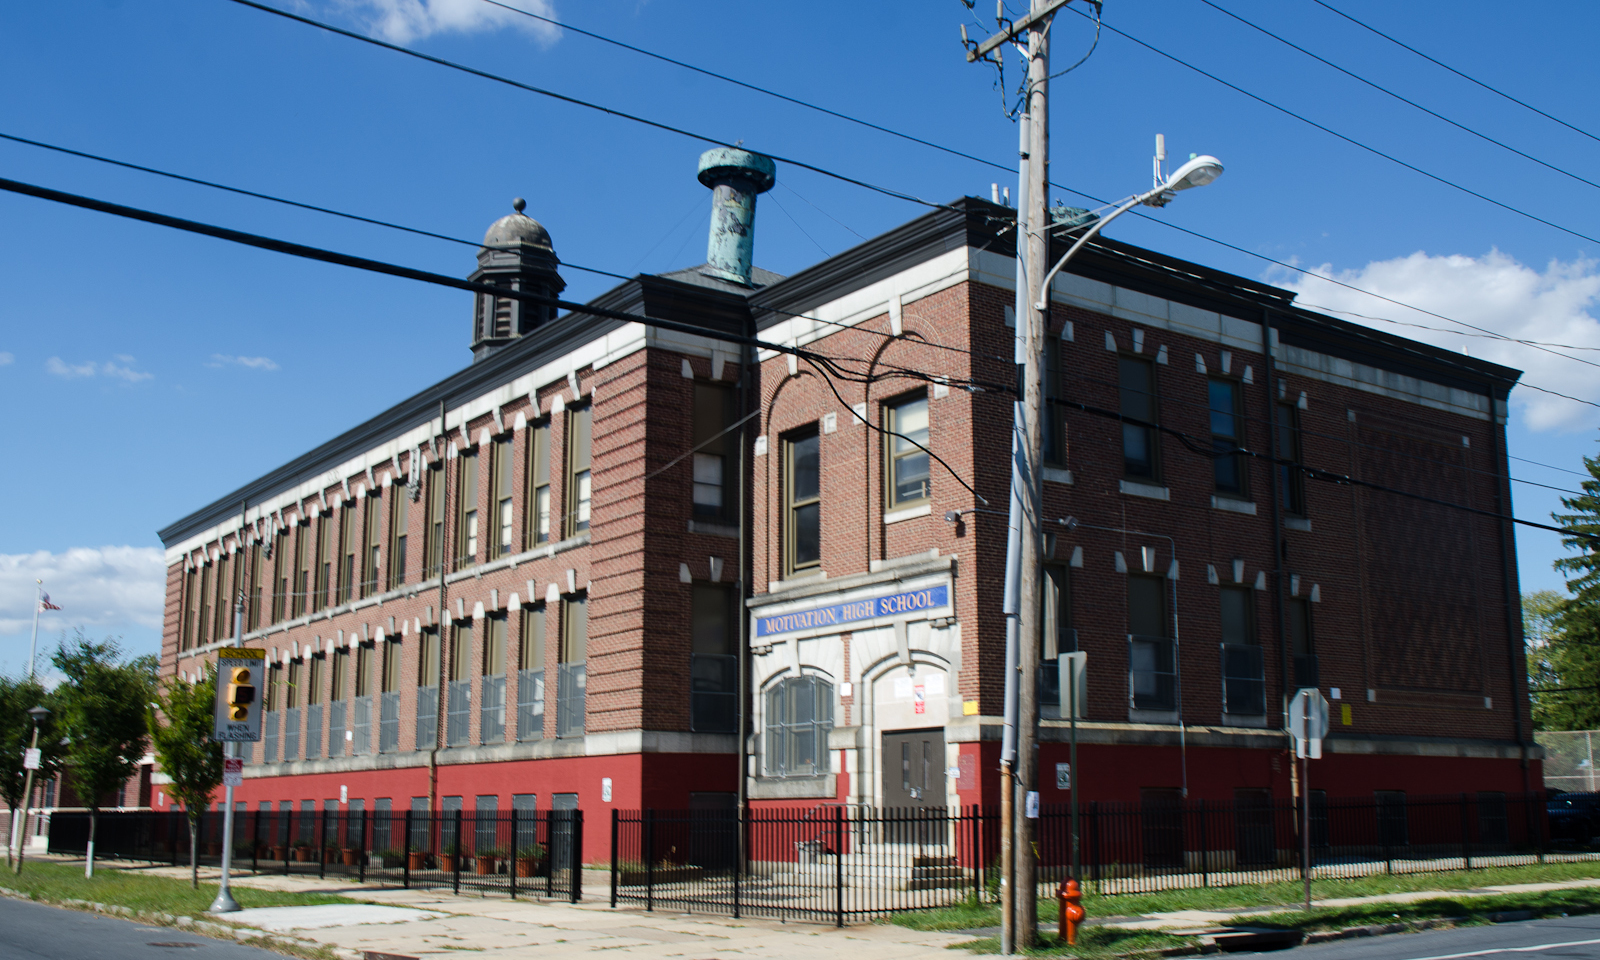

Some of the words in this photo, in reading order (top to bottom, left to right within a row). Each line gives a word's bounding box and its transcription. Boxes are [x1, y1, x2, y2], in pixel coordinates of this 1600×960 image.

[765, 608, 836, 634] MOTIVATION
[842, 600, 876, 620] HIGH
[880, 591, 935, 615] SCHOOL
[220, 659, 243, 667] SPEED
[245, 659, 261, 667] LIMIT
[218, 731, 257, 740] FLASHING
